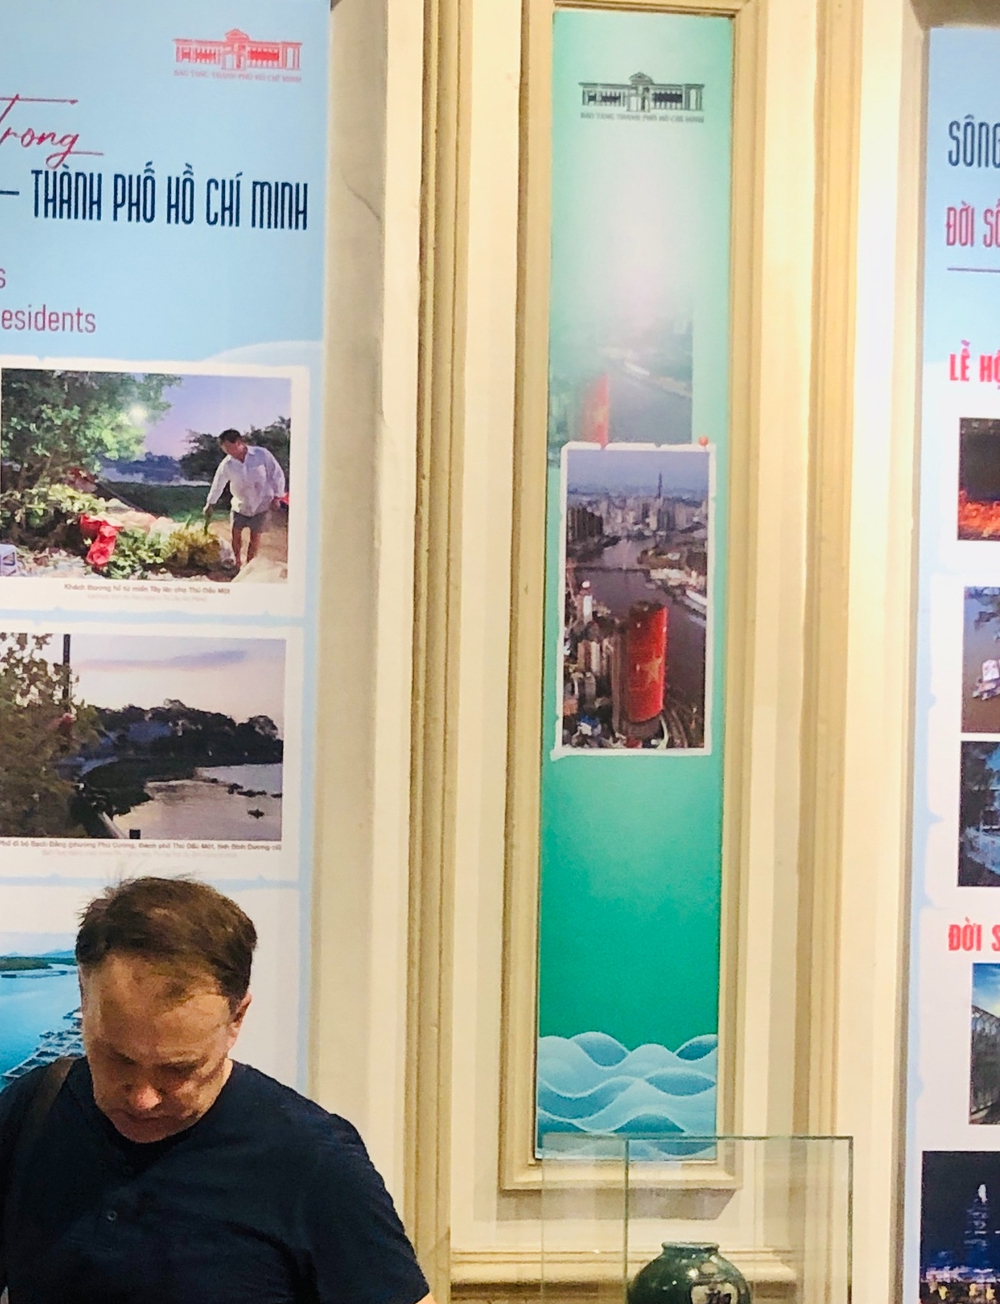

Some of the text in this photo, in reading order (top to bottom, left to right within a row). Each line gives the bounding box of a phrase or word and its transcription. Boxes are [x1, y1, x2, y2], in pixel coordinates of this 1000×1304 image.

[30, 164, 103, 222] THÀNH
[113, 160, 156, 223] PHỐ
[166, 163, 195, 225] HỒ
[206, 171, 244, 228] CHÍ
[251, 181, 308, 231] MINH
[946, 200, 975, 247] ĐỜI
[948, 916, 982, 952] ĐỜI
